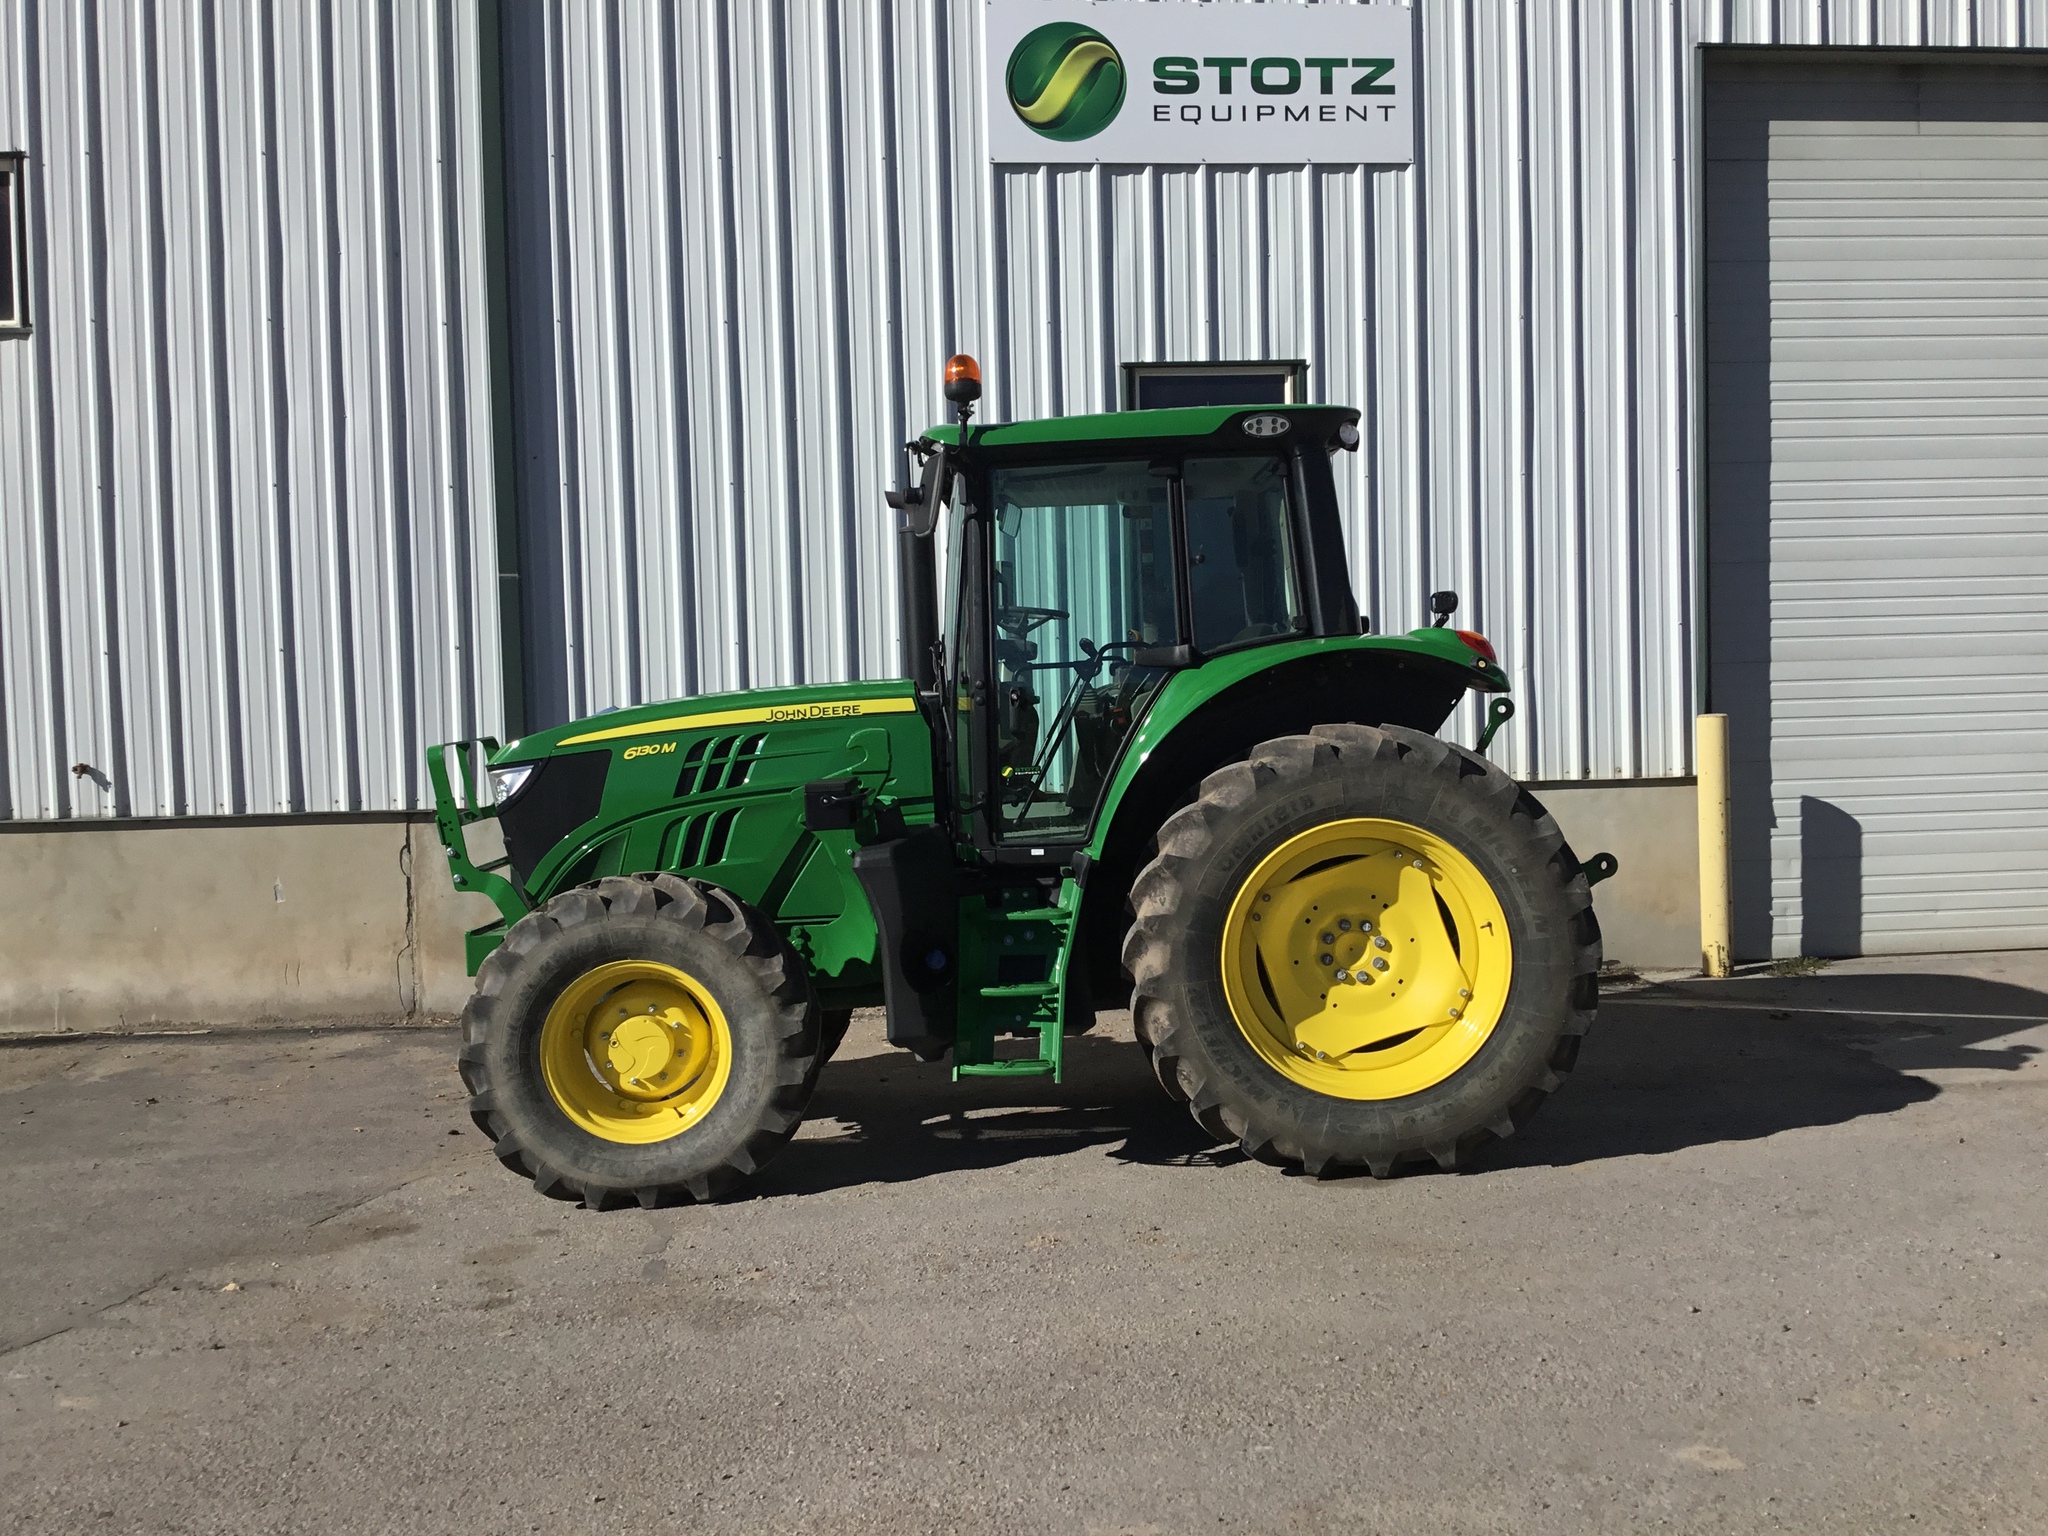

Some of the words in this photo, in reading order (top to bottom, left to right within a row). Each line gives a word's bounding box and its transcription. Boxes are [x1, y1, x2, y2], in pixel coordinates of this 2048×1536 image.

[1153, 56, 1396, 95] STOTZ
[1153, 105, 1396, 126] EQUIPMENT
[766, 708, 807, 721] JOHN
[809, 704, 862, 717] DEERE
